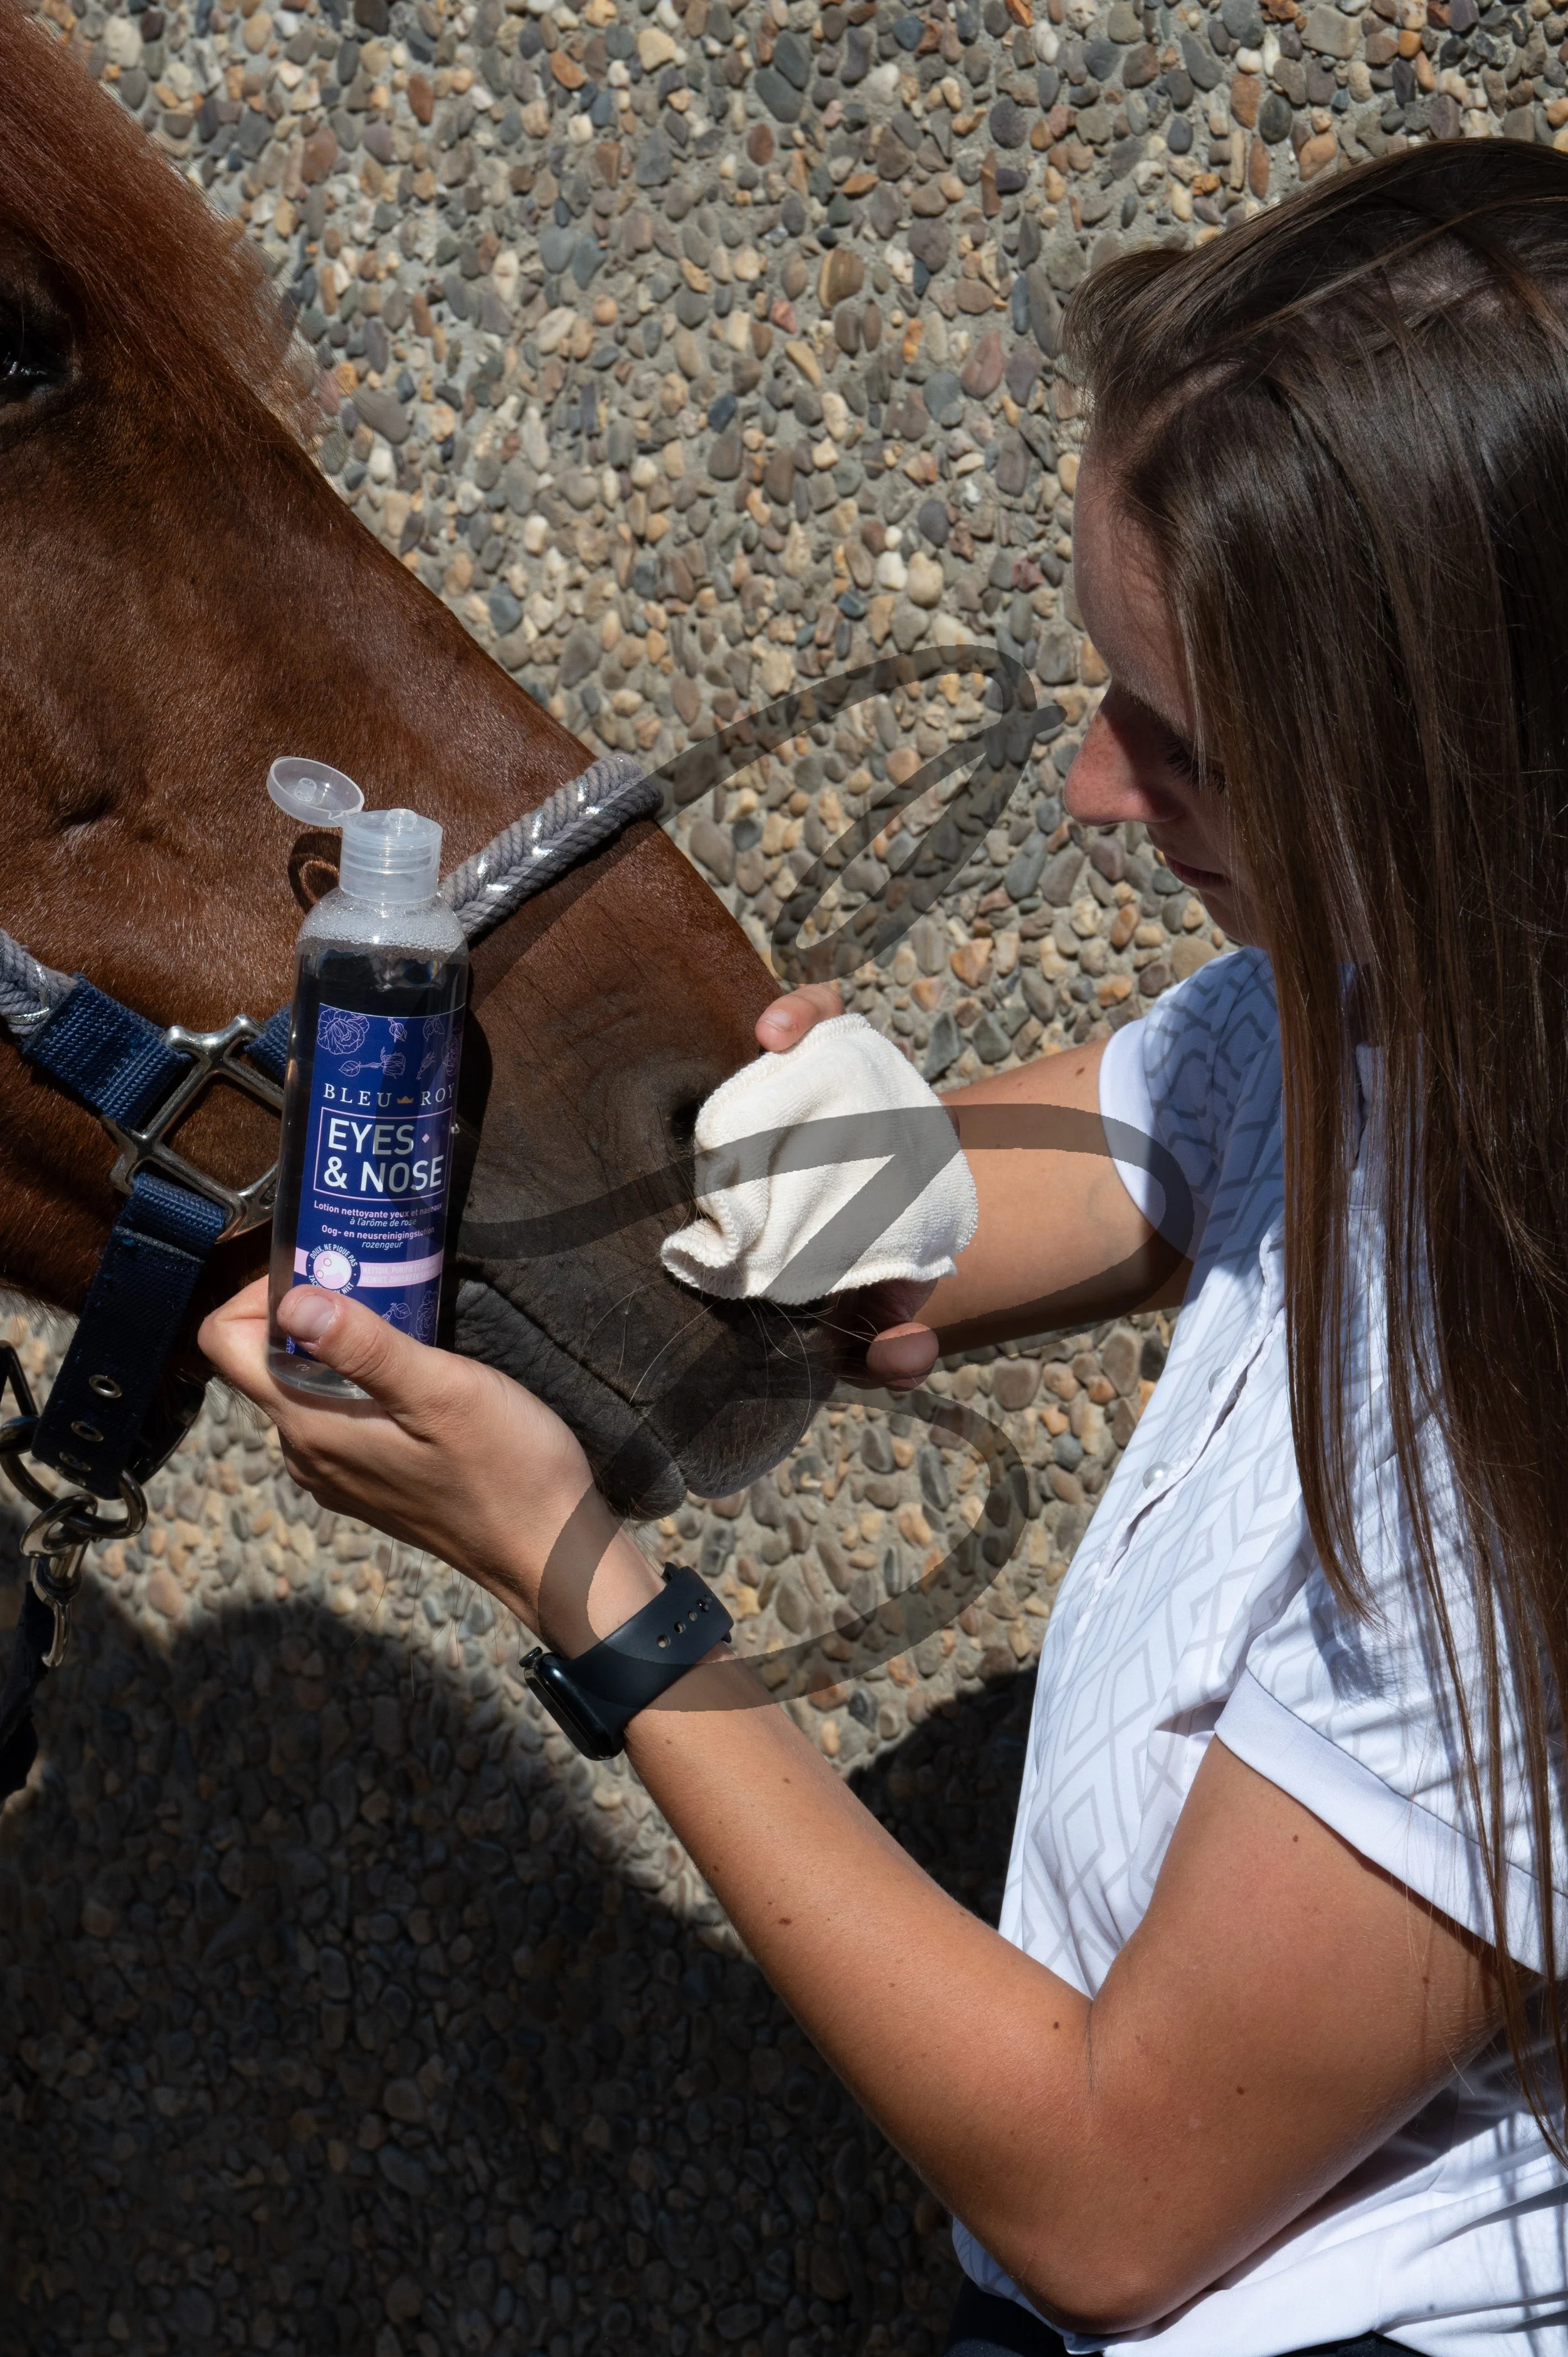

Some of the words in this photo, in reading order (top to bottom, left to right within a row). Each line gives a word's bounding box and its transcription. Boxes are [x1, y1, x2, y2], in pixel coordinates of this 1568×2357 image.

[323, 1083, 392, 1107] BLEU
[420, 1083, 455, 1106] ROY
[328, 1117, 415, 1155] EYES
[324, 1156, 347, 1189] &
[360, 1155, 444, 1192] NOSE
[314, 1200, 339, 1213] Lotion
[341, 1208, 388, 1219] nettoyante
[390, 1211, 409, 1220] yeux
[420, 1203, 442, 1216] naseaux
[349, 1216, 356, 1225] à
[389, 1219, 399, 1227] de
[322, 1225, 342, 1237] Oog-
[357, 1226, 435, 1241] neusreinigingslotion
[332, 1244, 351, 1257] PIQUE
[347, 1255, 358, 1267] PAS
[361, 1242, 403, 1250] rozengeur
[341, 1282, 354, 1294] NIET
